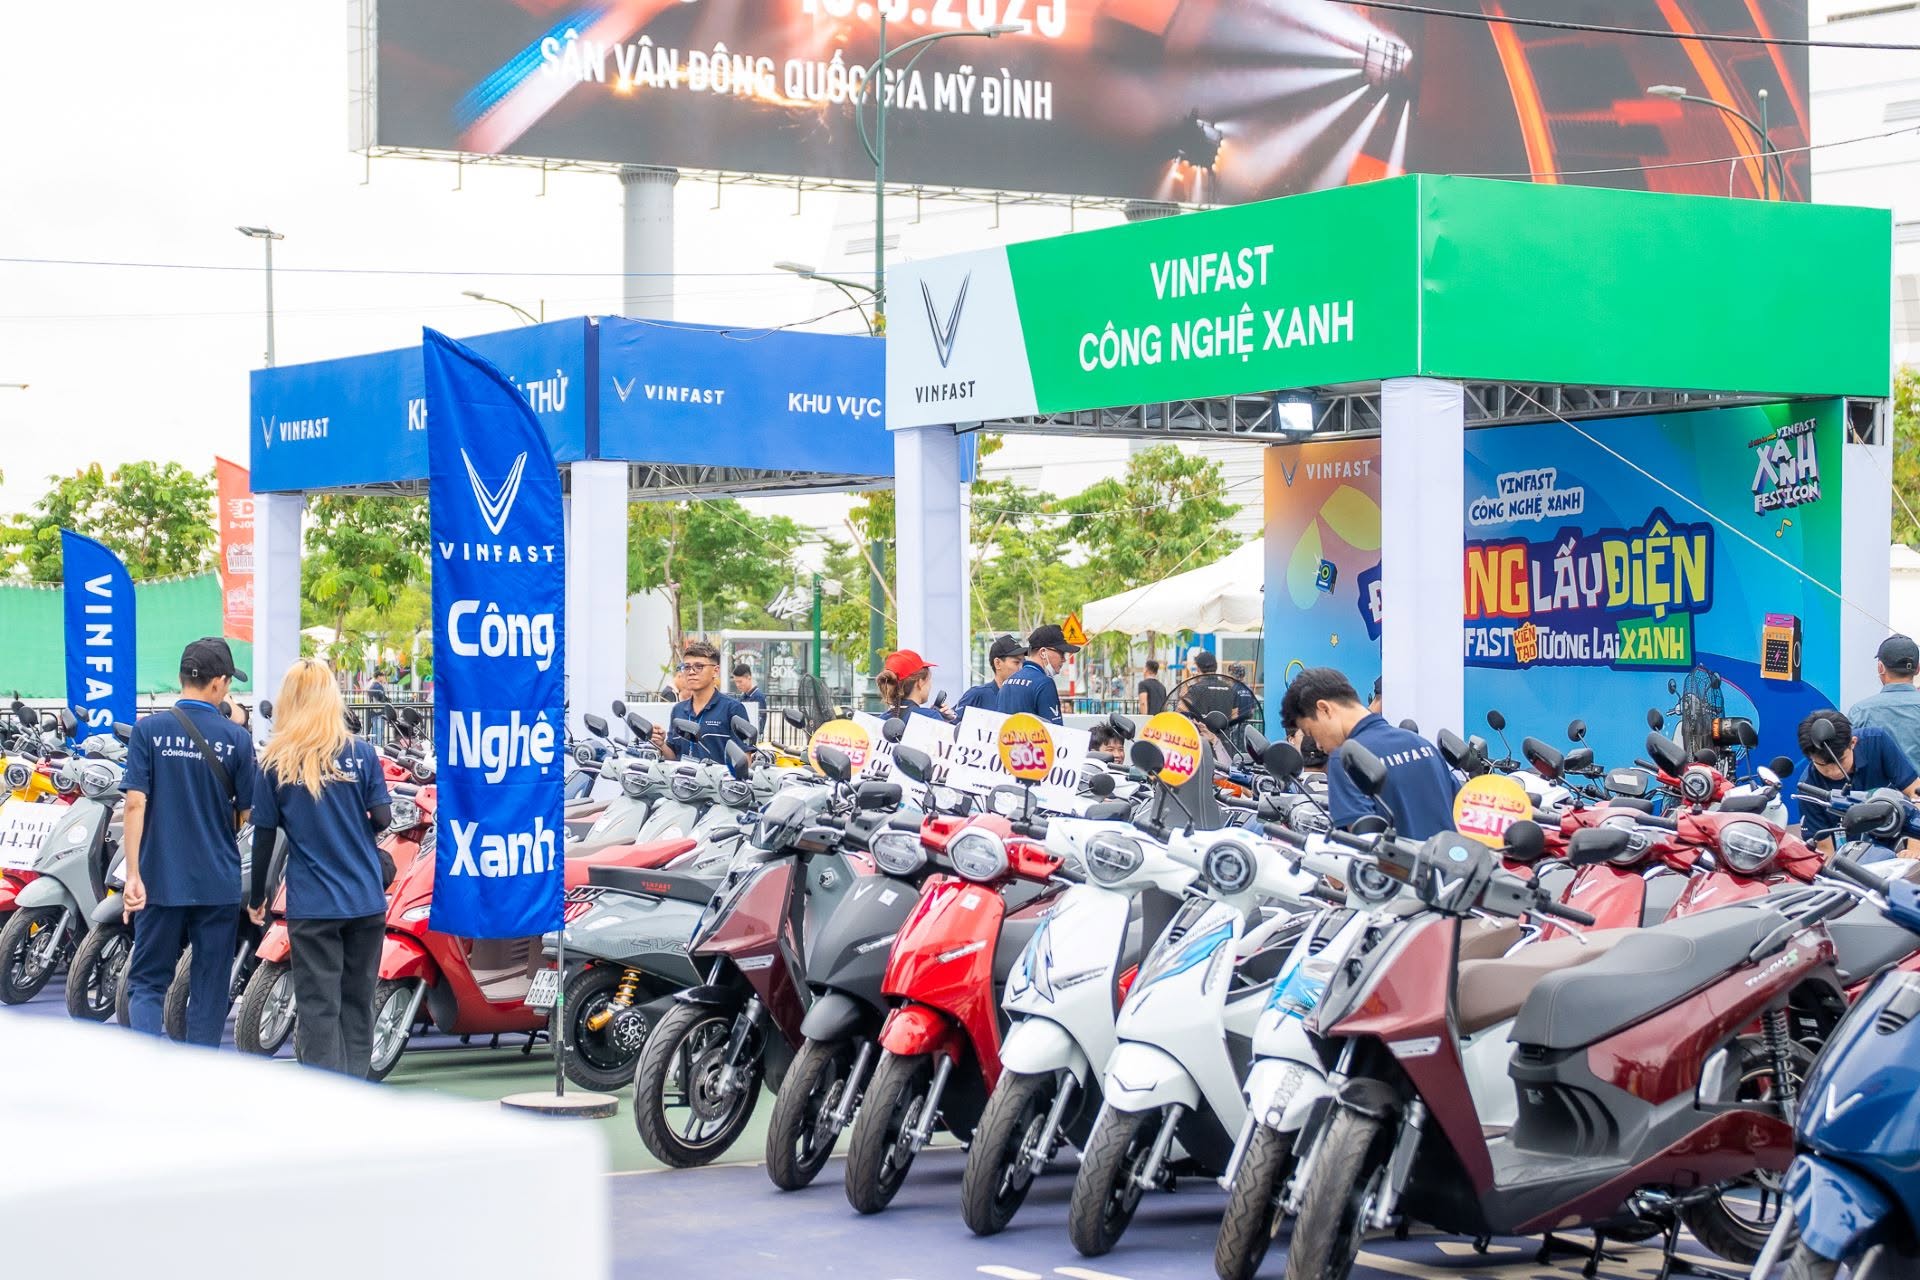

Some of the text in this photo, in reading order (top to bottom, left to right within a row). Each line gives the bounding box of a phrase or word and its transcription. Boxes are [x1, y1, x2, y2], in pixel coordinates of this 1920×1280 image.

[933, 64, 977, 115] MỸ
[981, 67, 1053, 120] ĐÌNH
[1150, 244, 1274, 300] VINFAST
[1078, 300, 1355, 372] CÔNG NGHỆ XANH
[643, 384, 726, 405] VINFAST
[787, 392, 882, 420] KHU VỰC
[914, 380, 976, 404] VINFAST
[279, 417, 330, 442] VINFAST
[1305, 460, 1371, 480] VINFAST
[1500, 472, 1554, 495] VINFAST
[1471, 491, 1582, 521] CÔNG NGHỆ XANH
[438, 542, 556, 563] VINFAST
[84, 573, 114, 729] VINFAS
[447, 599, 556, 673] Công
[1618, 626, 1685, 660] XANH
[448, 709, 556, 785] Nghệ
[448, 816, 556, 878] Xanh
